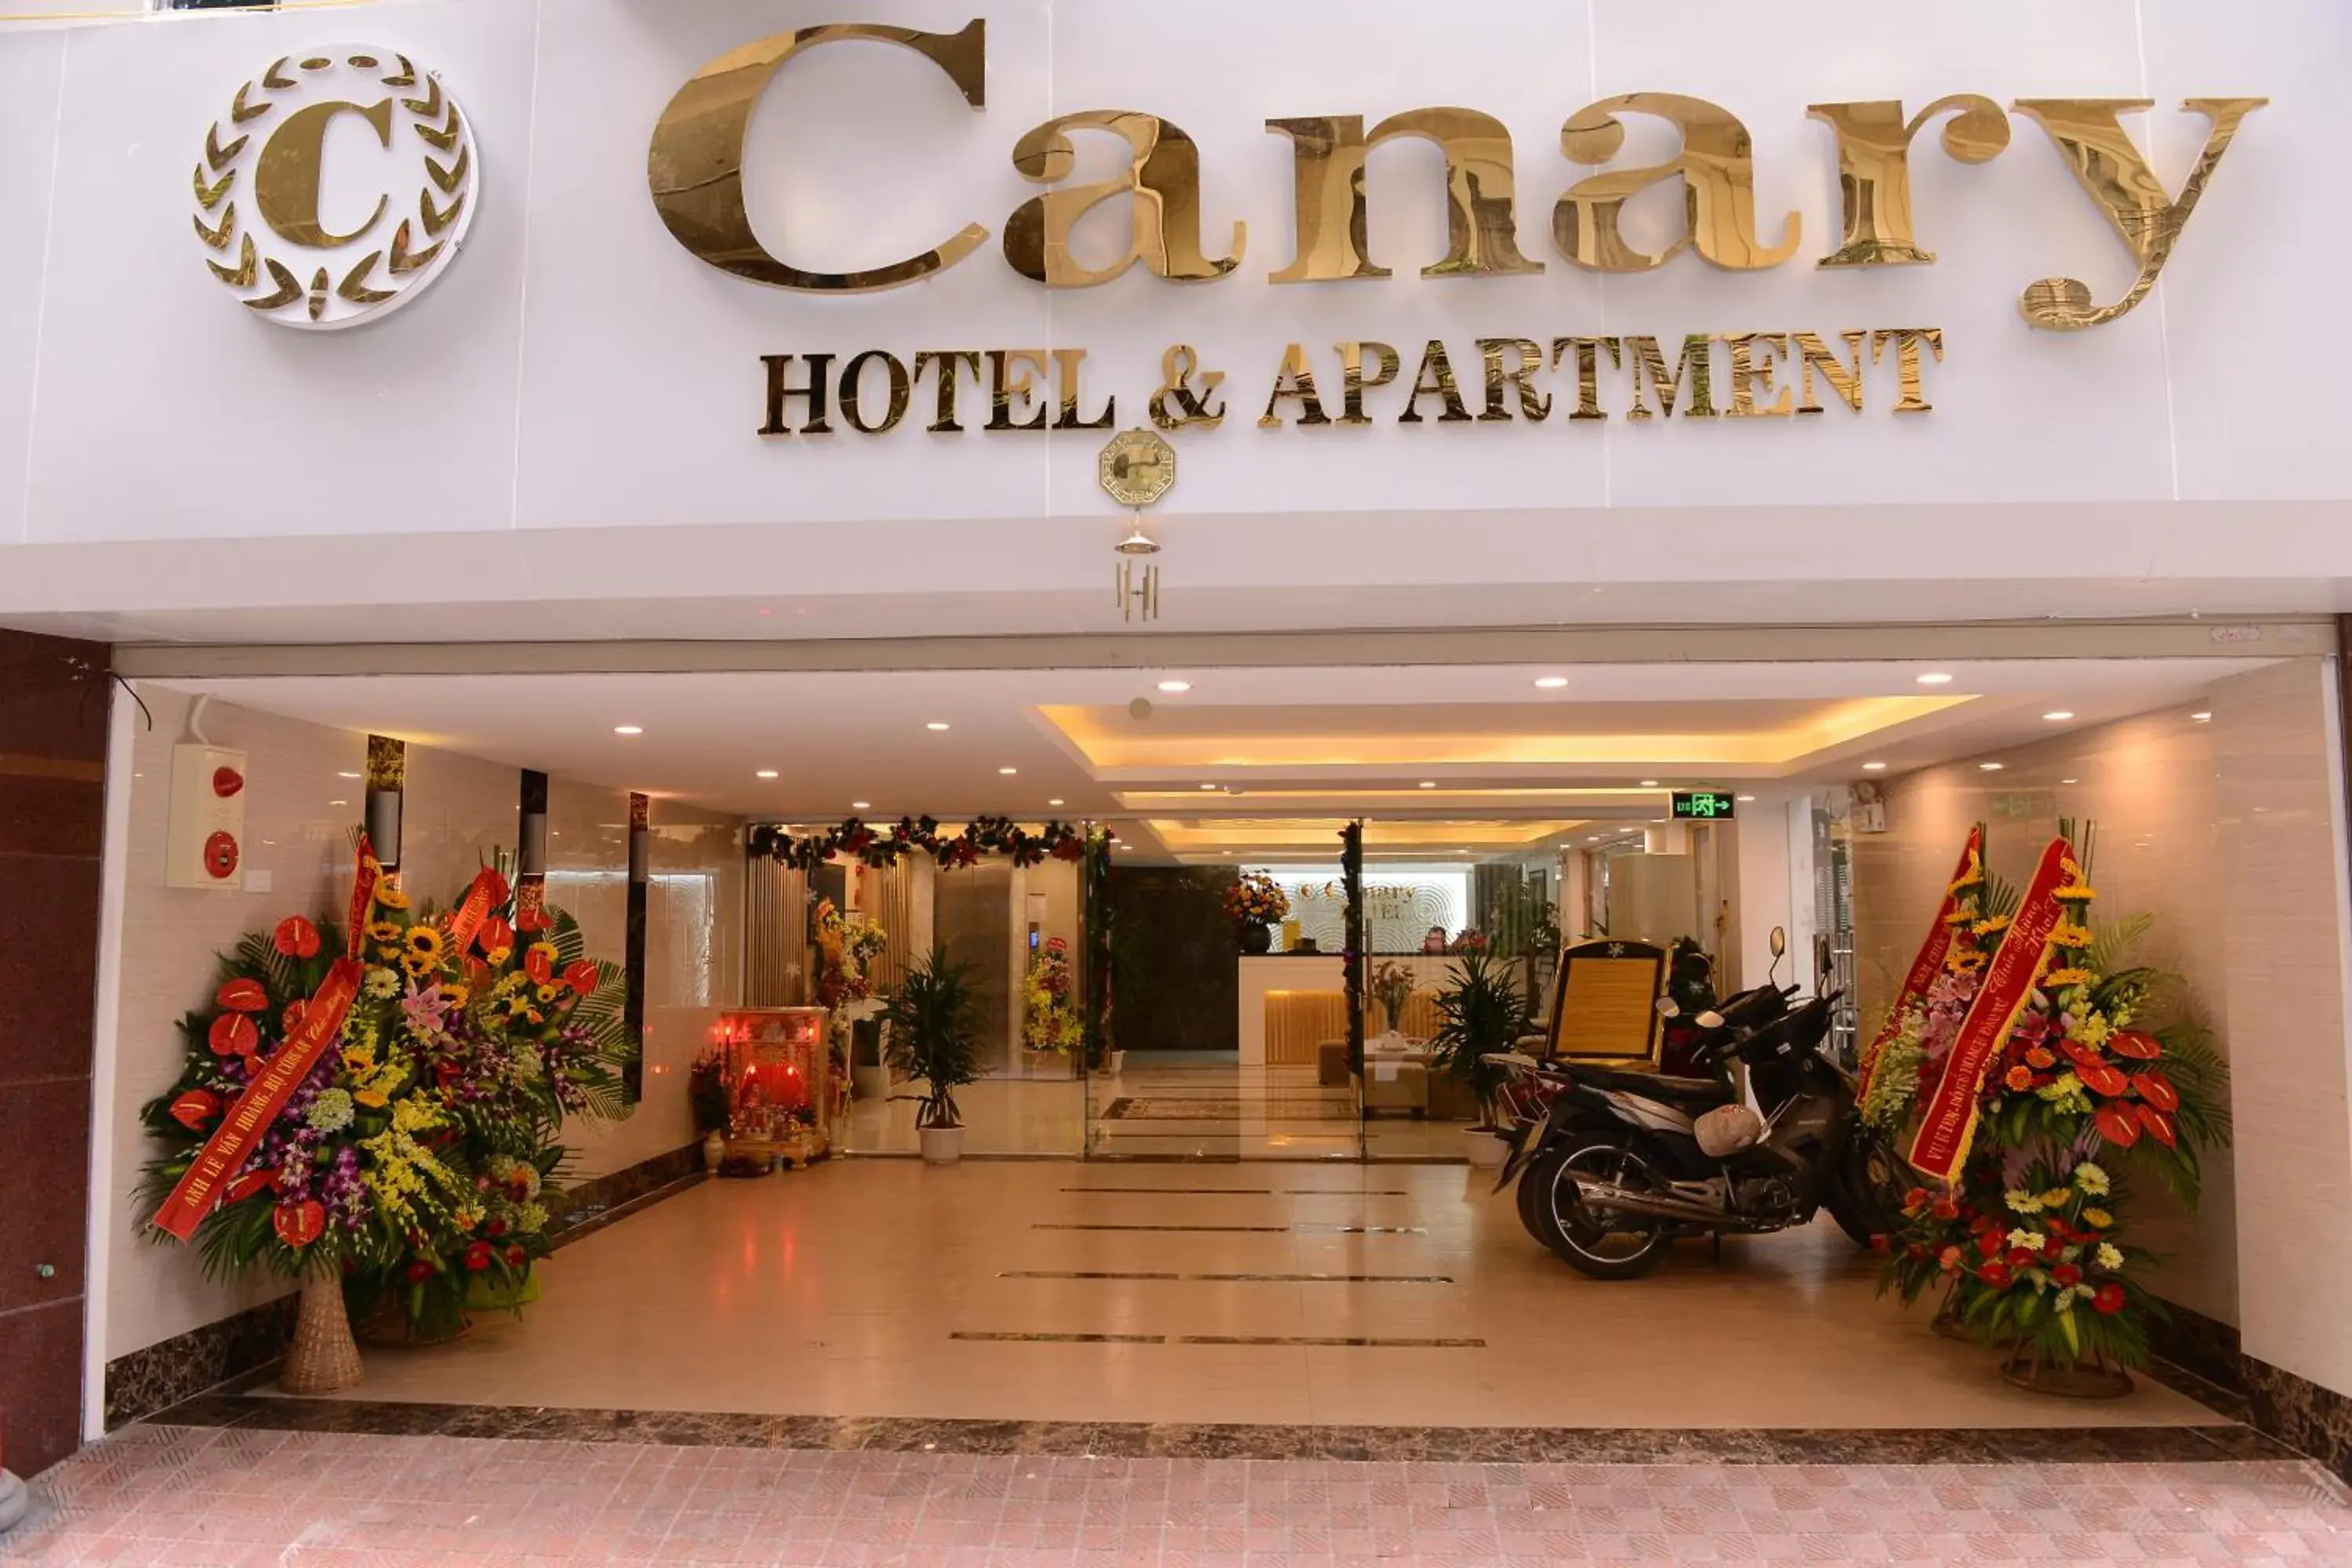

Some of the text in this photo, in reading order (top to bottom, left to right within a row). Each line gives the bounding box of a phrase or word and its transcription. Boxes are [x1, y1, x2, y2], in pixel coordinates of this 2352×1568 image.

[255, 96, 393, 249] C
[648, 18, 2269, 331] Canary
[757, 326, 1944, 436] HOTEL & APARTMENT
[183, 1176, 209, 1207] ANH
